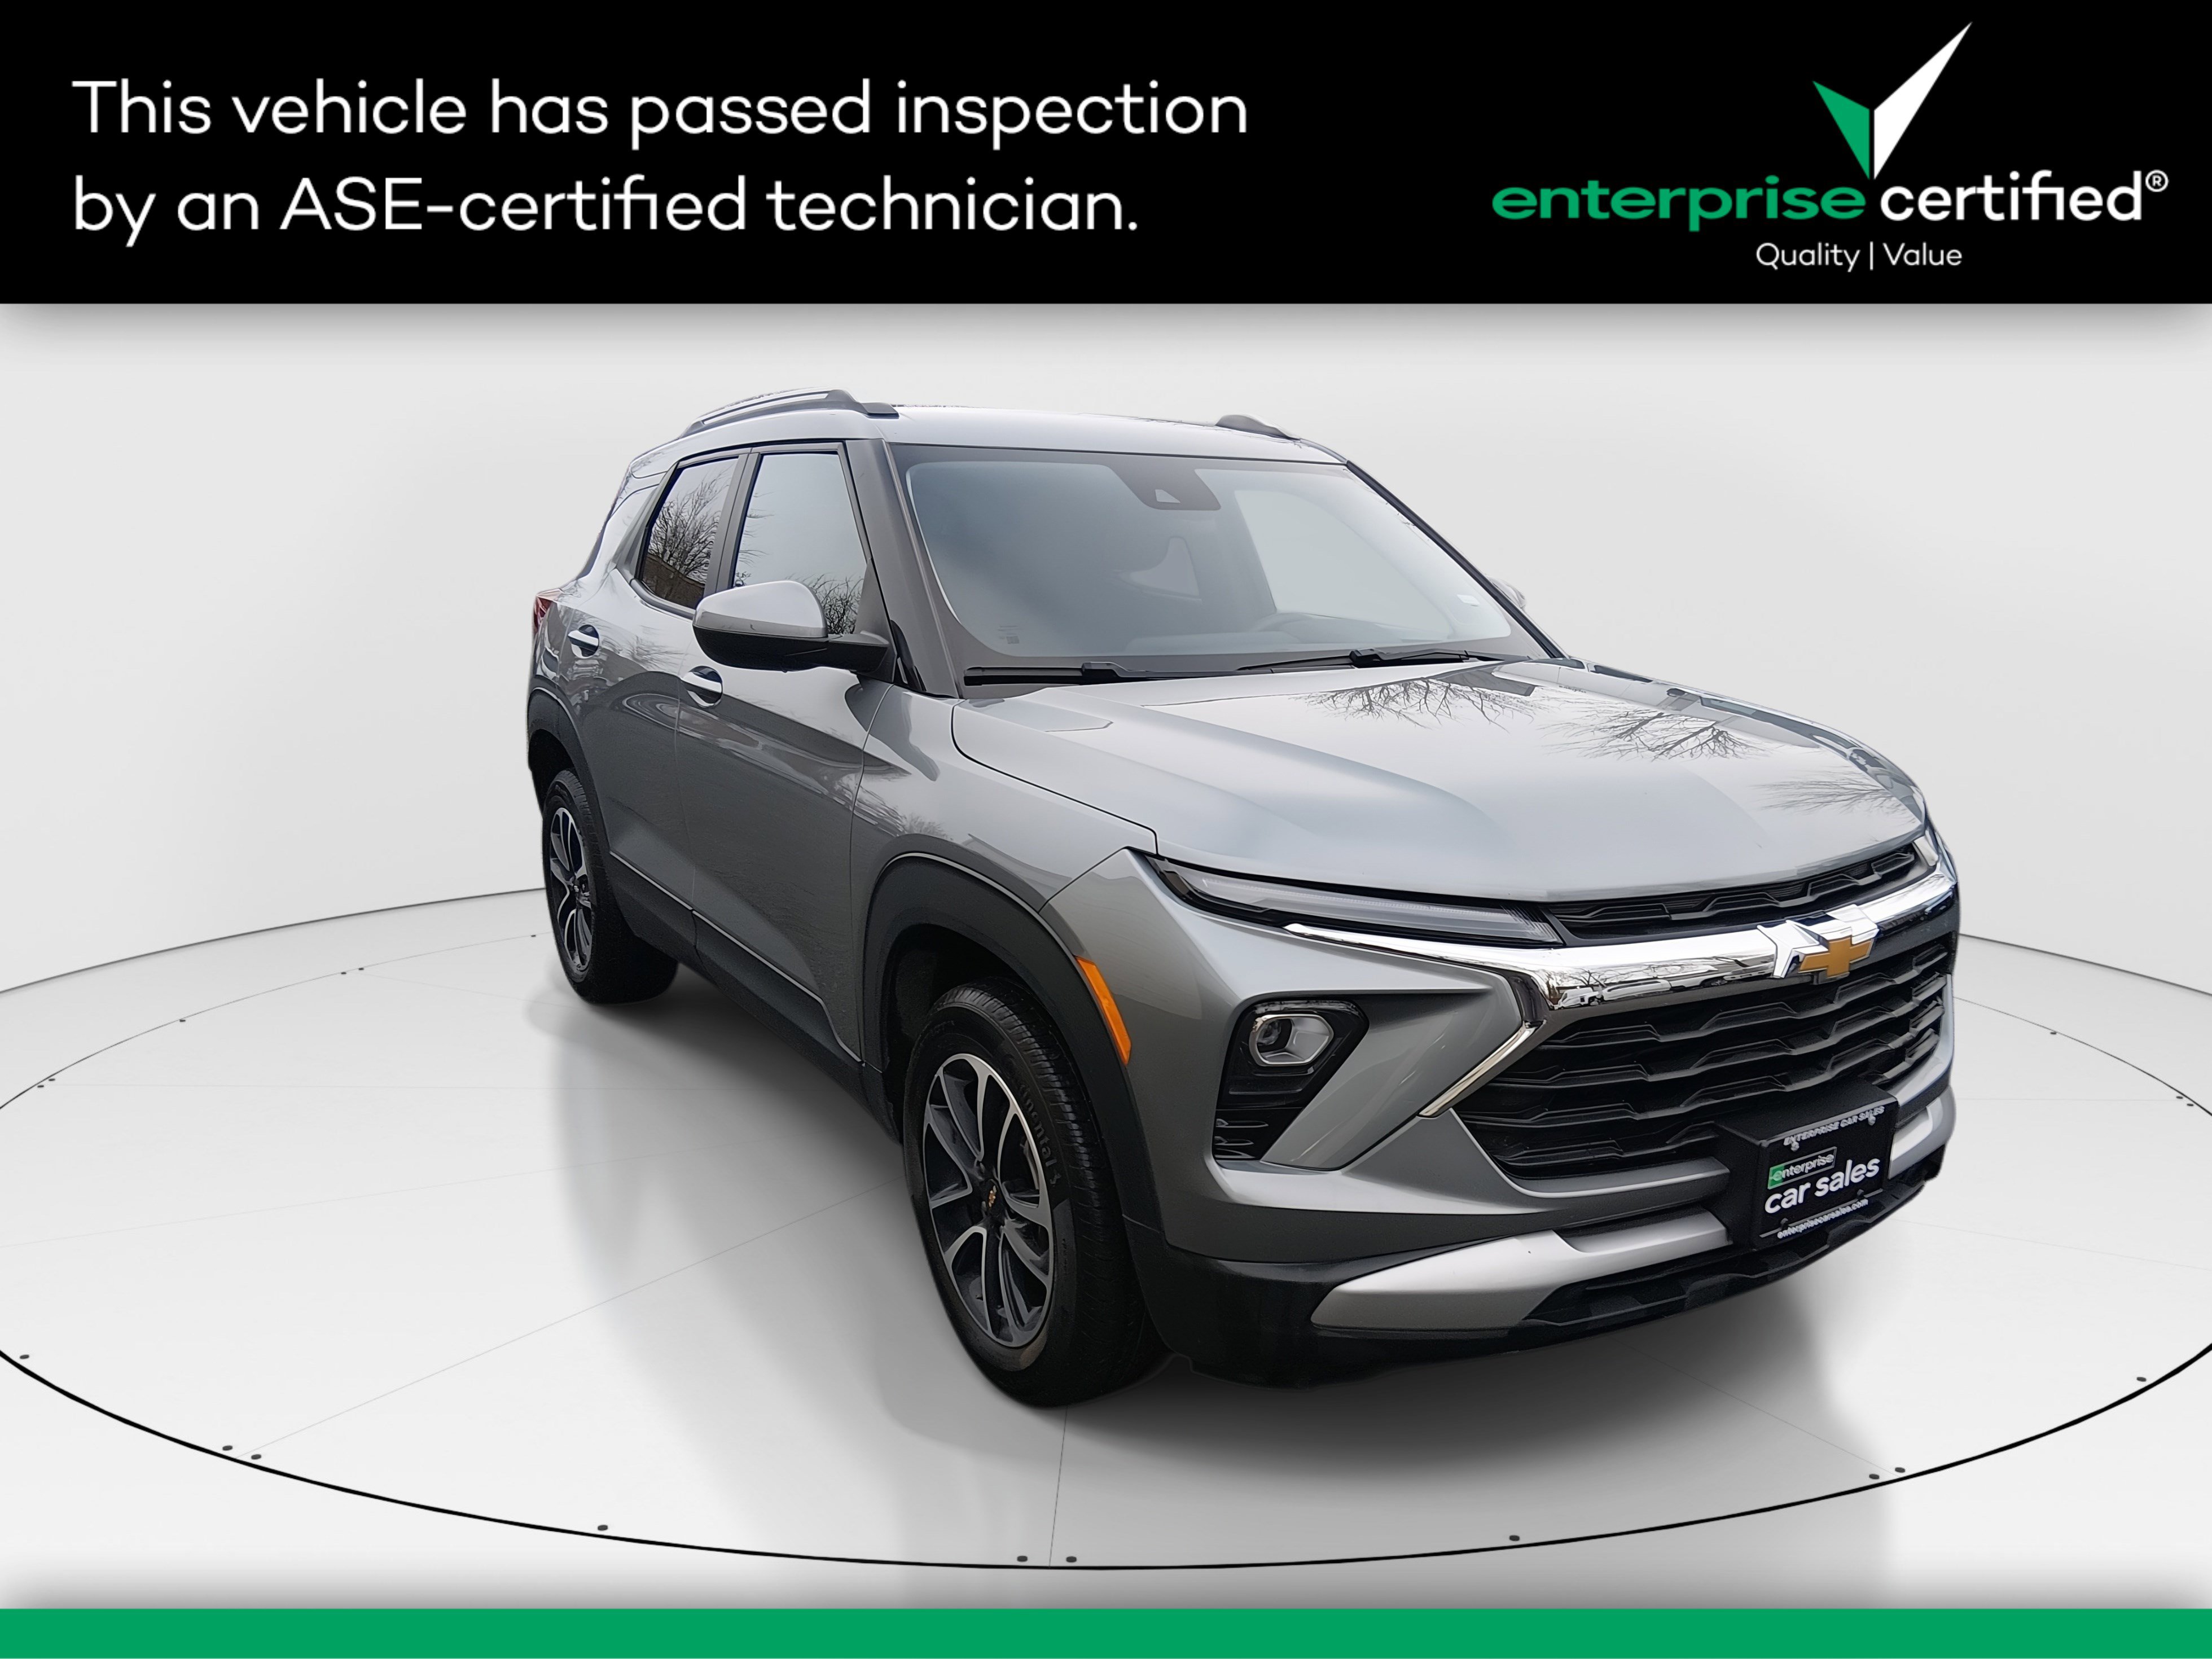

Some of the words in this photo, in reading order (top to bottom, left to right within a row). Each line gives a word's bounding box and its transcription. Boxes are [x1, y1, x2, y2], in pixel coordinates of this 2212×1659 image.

[1006, 1053, 1057, 1167] tinental
[1783, 1121, 1840, 1146] ENTERPRISE
[1840, 1115, 1859, 1127] CAR
[1765, 1182, 1811, 1214] car
[1814, 1158, 1881, 1197] sales
[1770, 1154, 1834, 1181] enterprise
